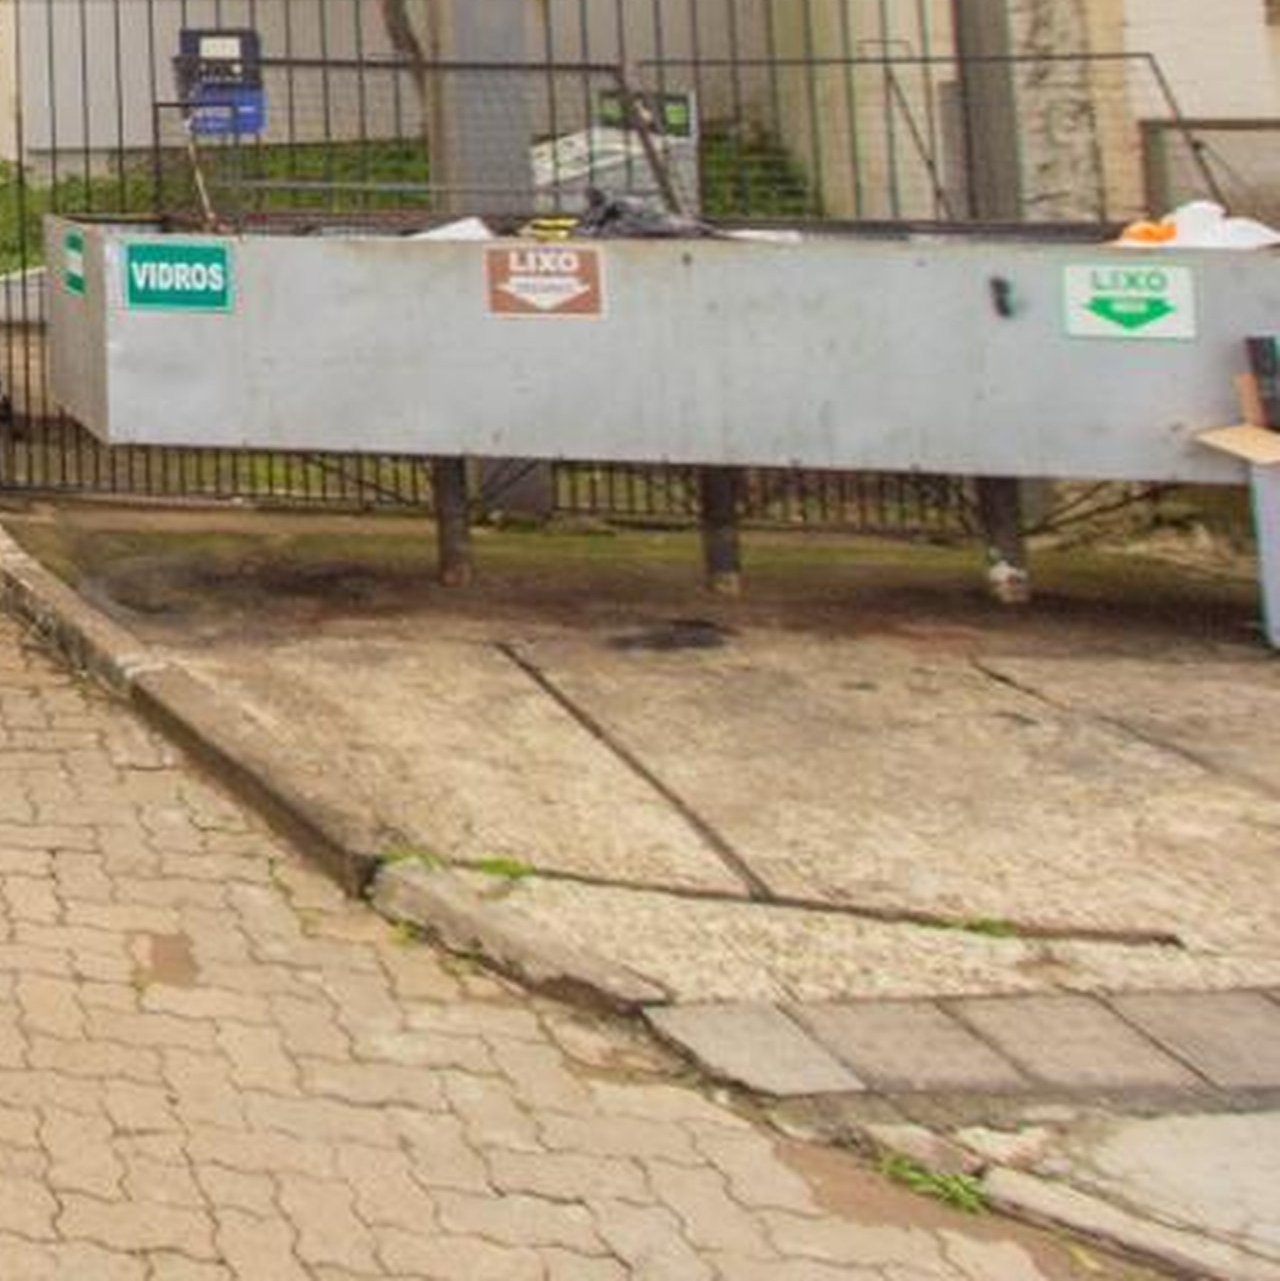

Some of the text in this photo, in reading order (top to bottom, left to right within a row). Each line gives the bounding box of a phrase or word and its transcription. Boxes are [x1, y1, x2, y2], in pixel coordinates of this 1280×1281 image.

[509, 251, 579, 272] LIXO
[130, 261, 224, 291] VIDROS
[1090, 270, 1168, 292] LIXO
